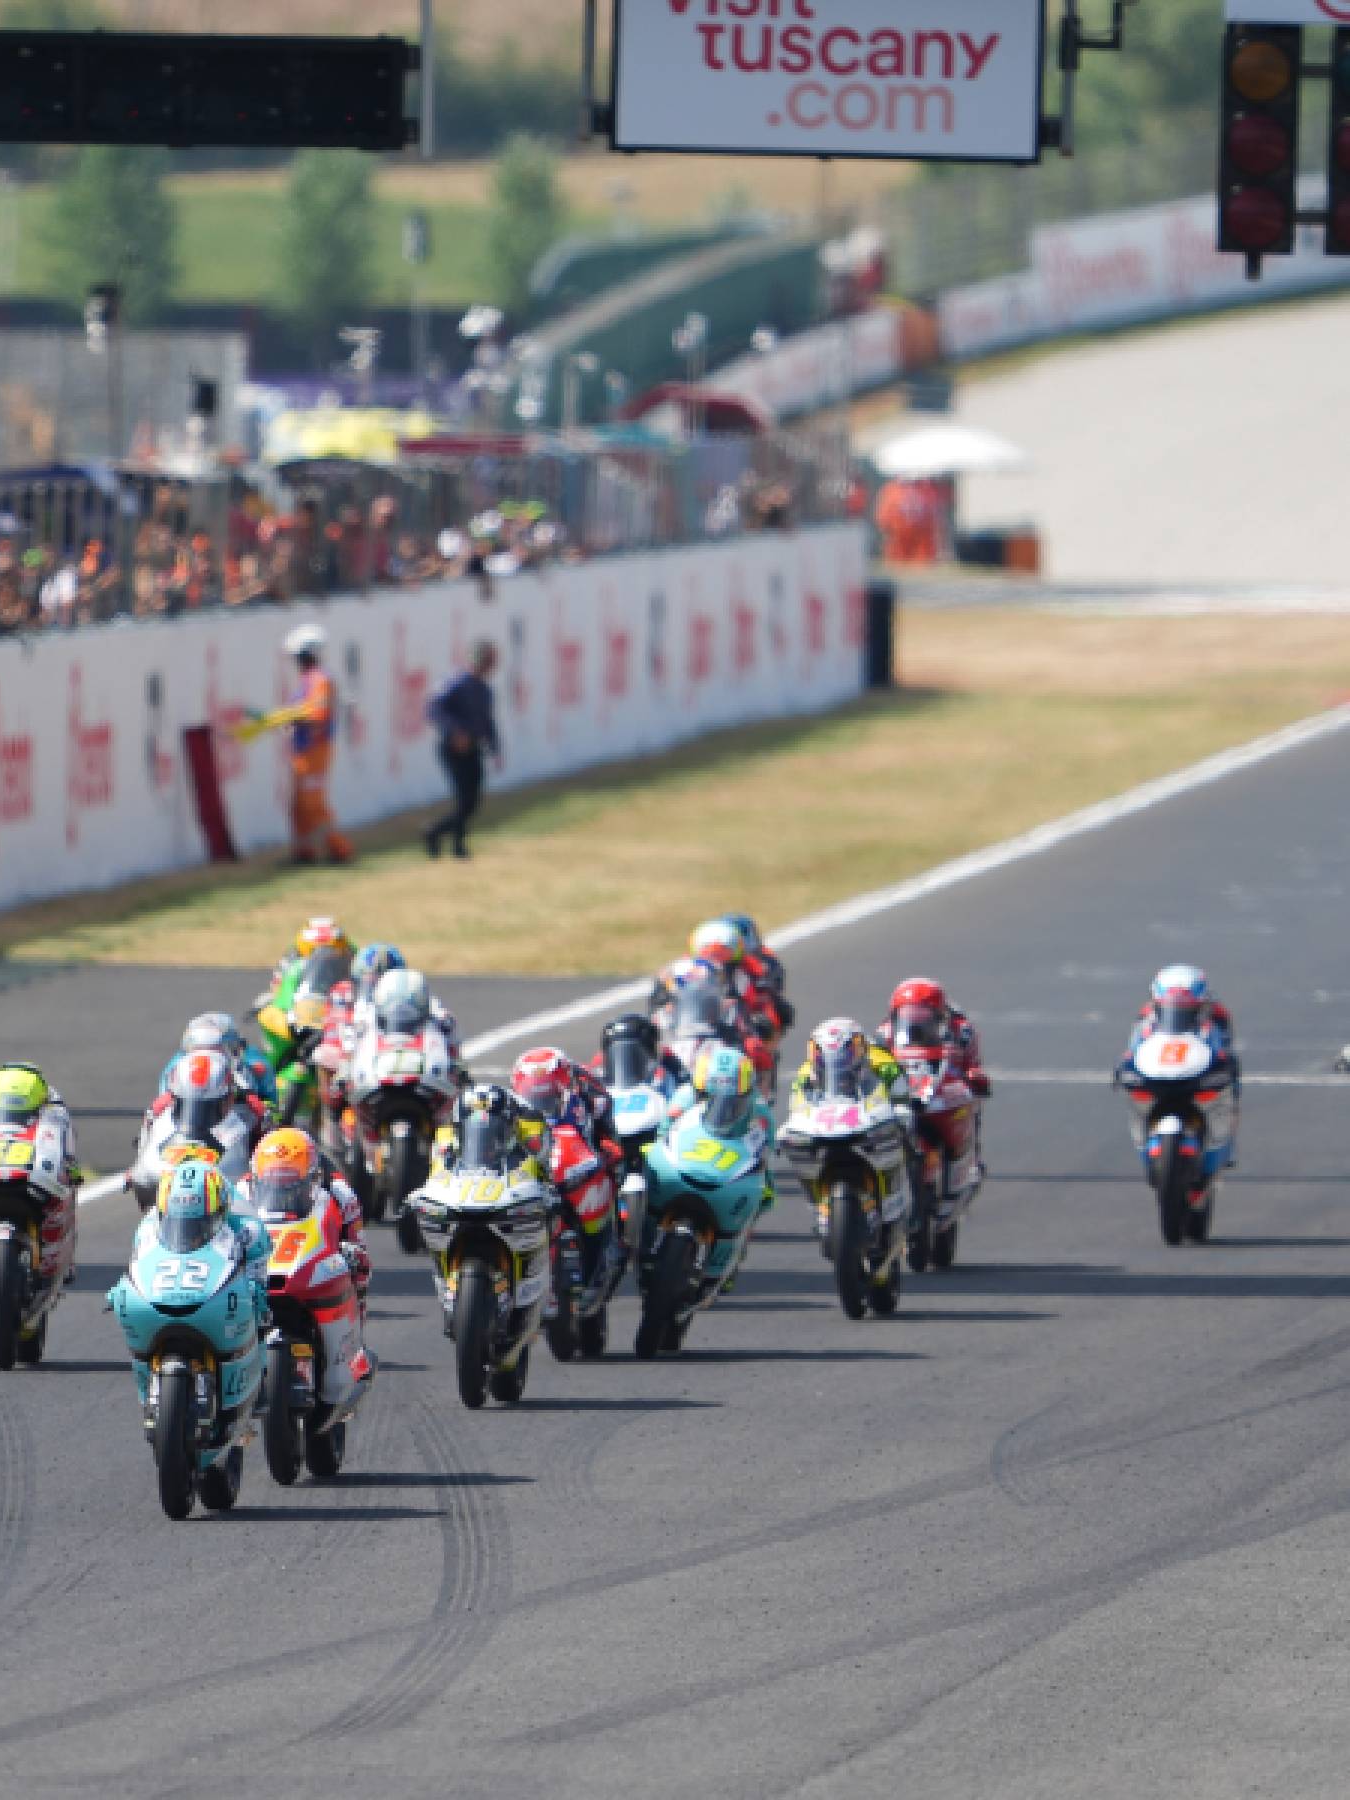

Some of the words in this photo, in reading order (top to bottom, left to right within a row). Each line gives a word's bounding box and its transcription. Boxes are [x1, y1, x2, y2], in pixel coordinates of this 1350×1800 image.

[696, 23, 1001, 80] tuscany
[765, 81, 956, 134] .com
[152, 1259, 210, 1291] 22
